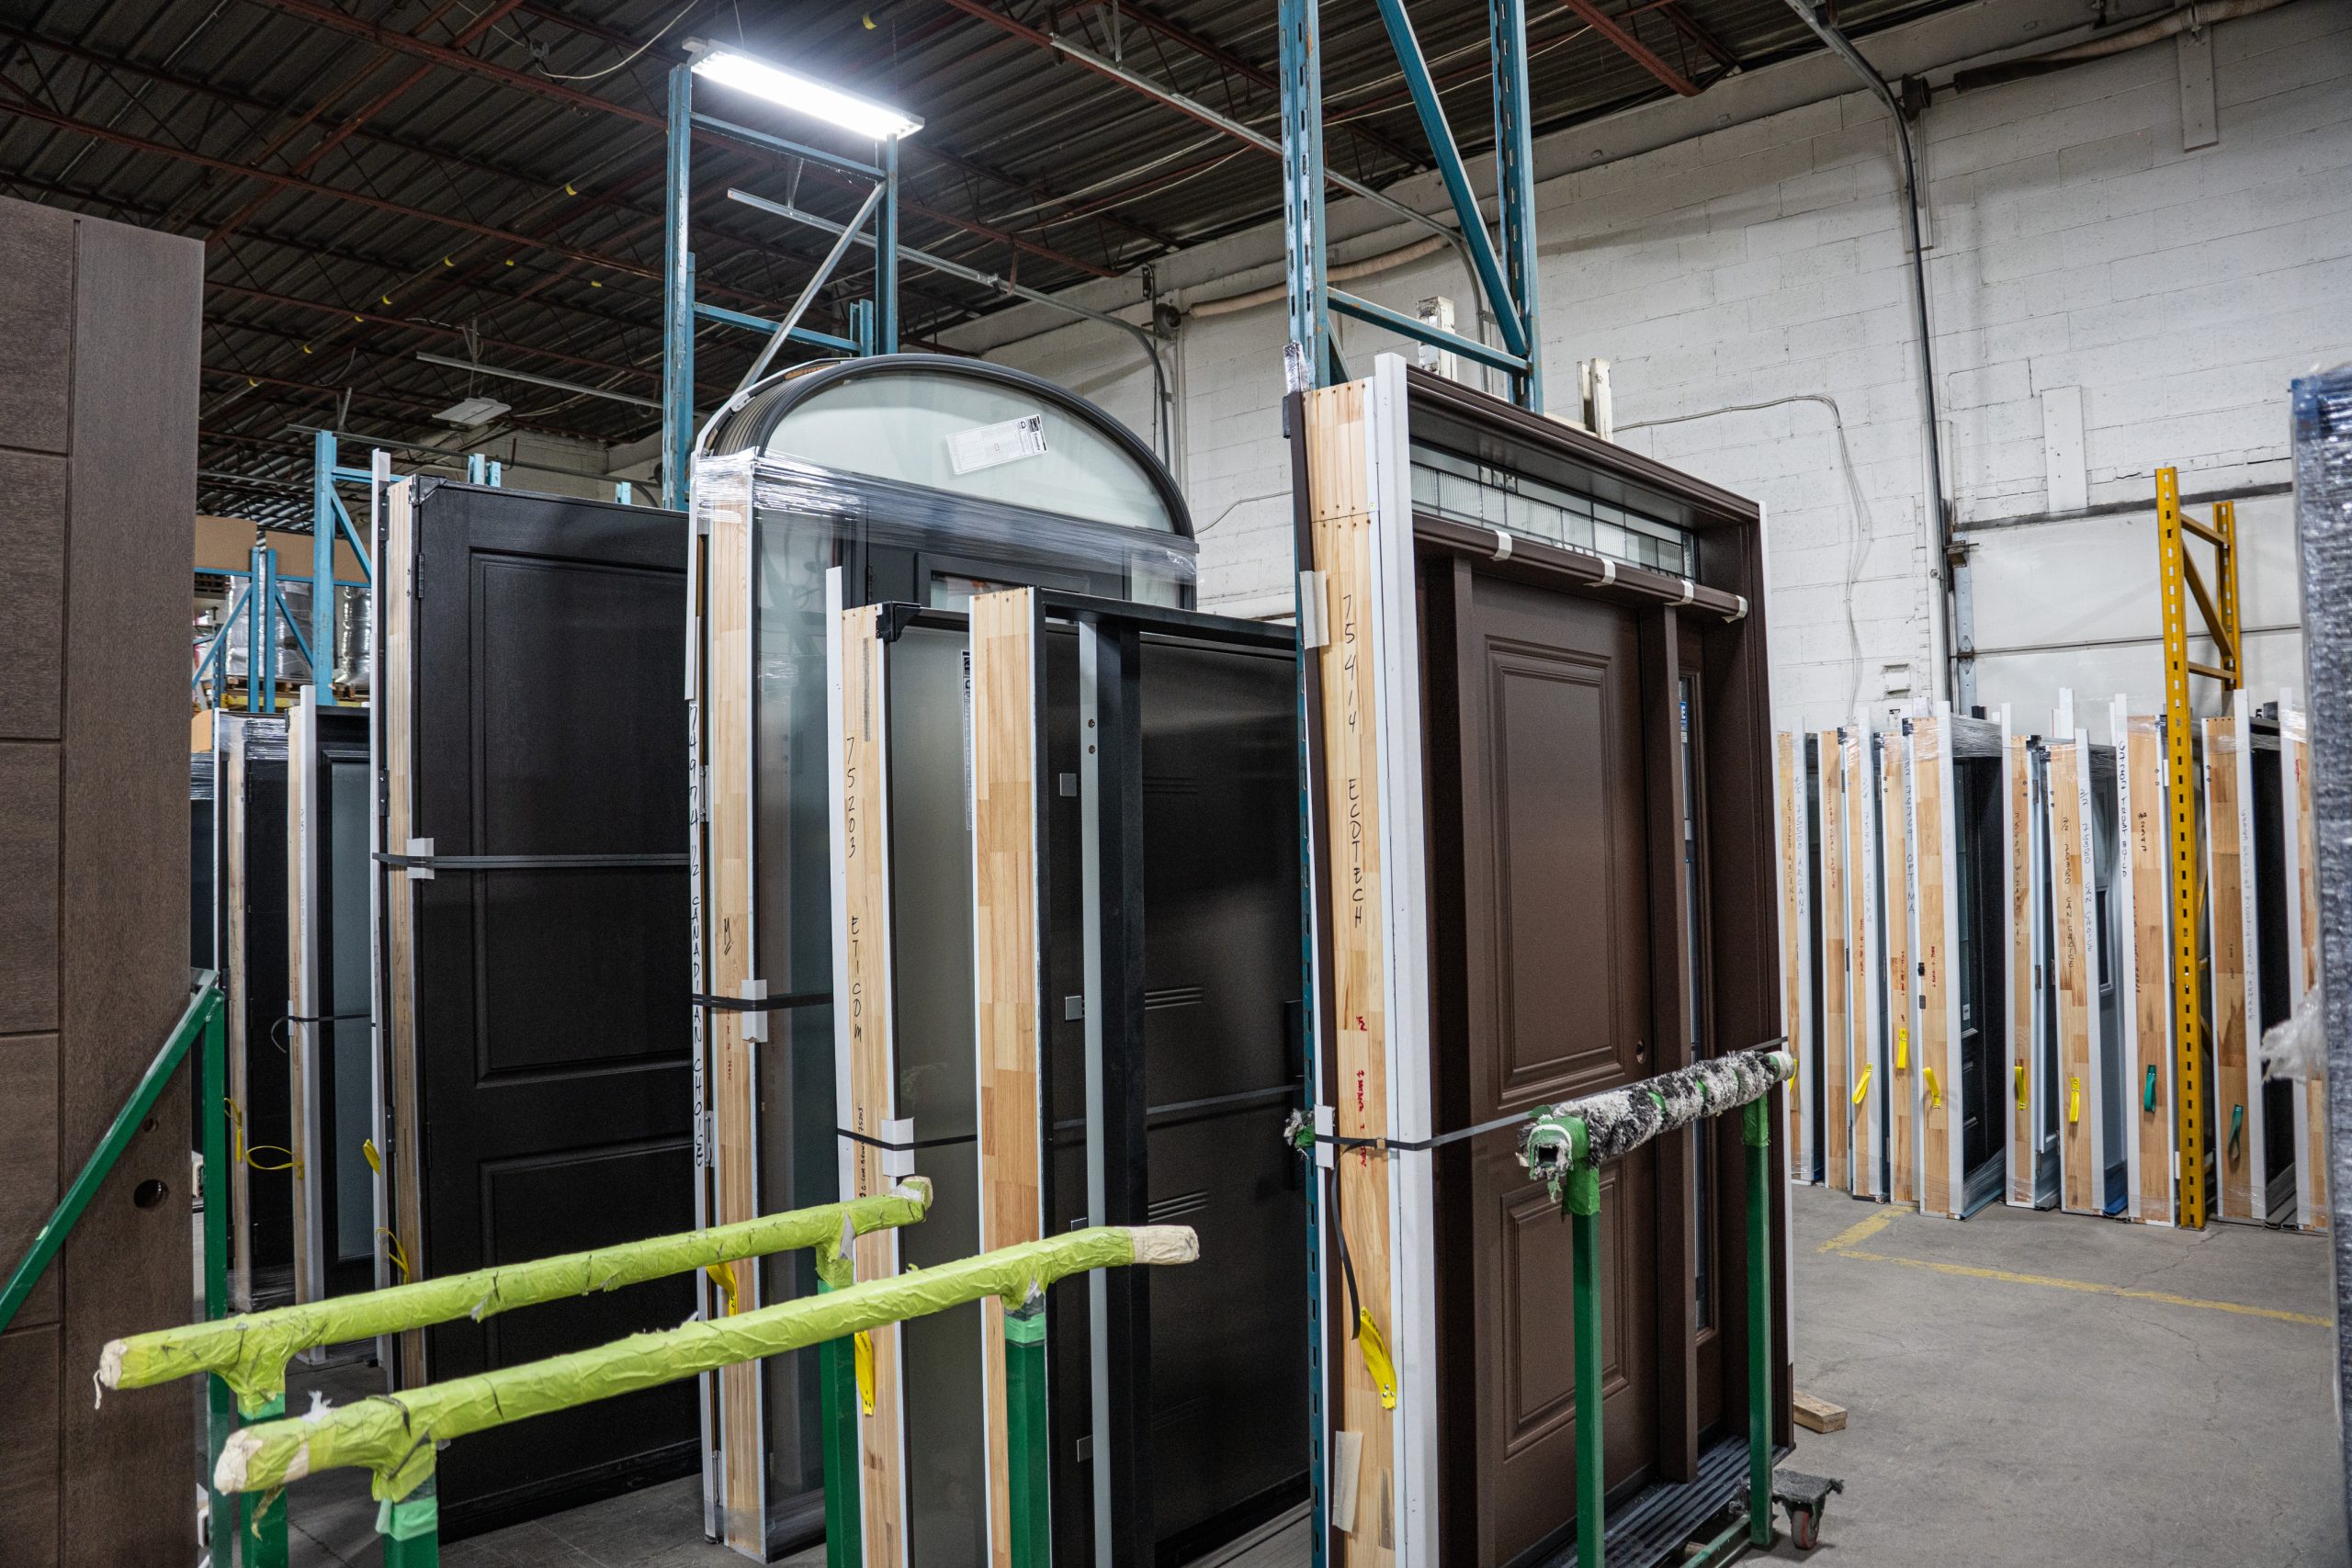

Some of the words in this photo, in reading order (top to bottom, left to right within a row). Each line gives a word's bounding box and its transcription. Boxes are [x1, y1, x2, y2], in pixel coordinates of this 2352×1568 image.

[1343, 594, 1357, 734] 75414
[689, 705, 698, 835] 74974
[846, 737, 856, 859] 75203
[852, 915, 863, 1043] ETICOM
[1348, 778, 1363, 929] ECOTECH
[1797, 856, 1805, 917] ARCANA
[1906, 852, 1916, 914] OPTIMA
[692, 896, 702, 1043] CANADIAN
[2067, 925, 2075, 969] CHOICE
[2085, 910, 2094, 953] CHOICE
[694, 1058, 704, 1168] CHOICE
